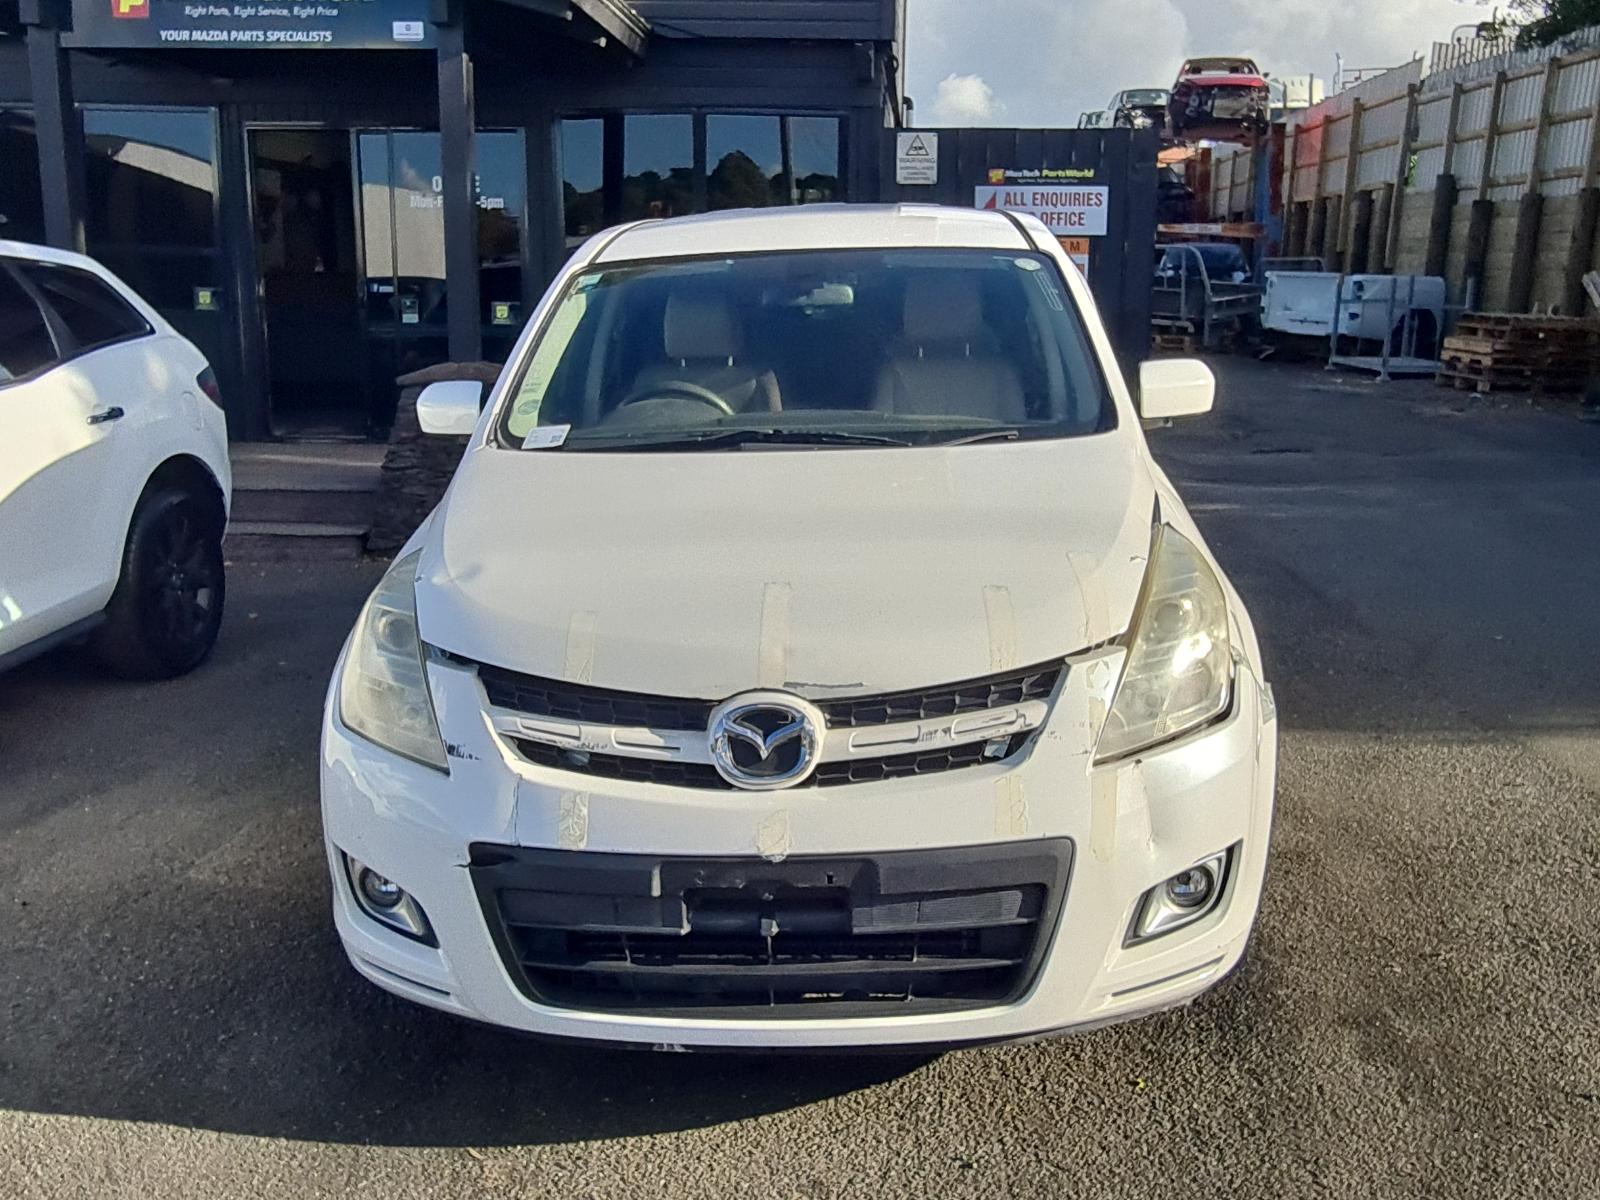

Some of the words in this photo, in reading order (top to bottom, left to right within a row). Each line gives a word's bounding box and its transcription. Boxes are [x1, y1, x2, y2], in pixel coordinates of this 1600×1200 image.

[185, 6, 207, 17] Right
[208, 6, 231, 16] Parts,
[233, 6, 256, 18] Right
[257, 6, 290, 17] Service,
[293, 6, 316, 18] Right
[317, 7, 338, 17] Price
[160, 30, 191, 42] YOUR
[191, 30, 229, 42] MAZDA
[230, 30, 265, 42] PARTS
[267, 30, 333, 42] SPECIALISTS
[1003, 192, 1027, 207] ALL
[1032, 192, 1103, 207] ENQUIRIES
[1040, 212, 1086, 226] OFFICE
